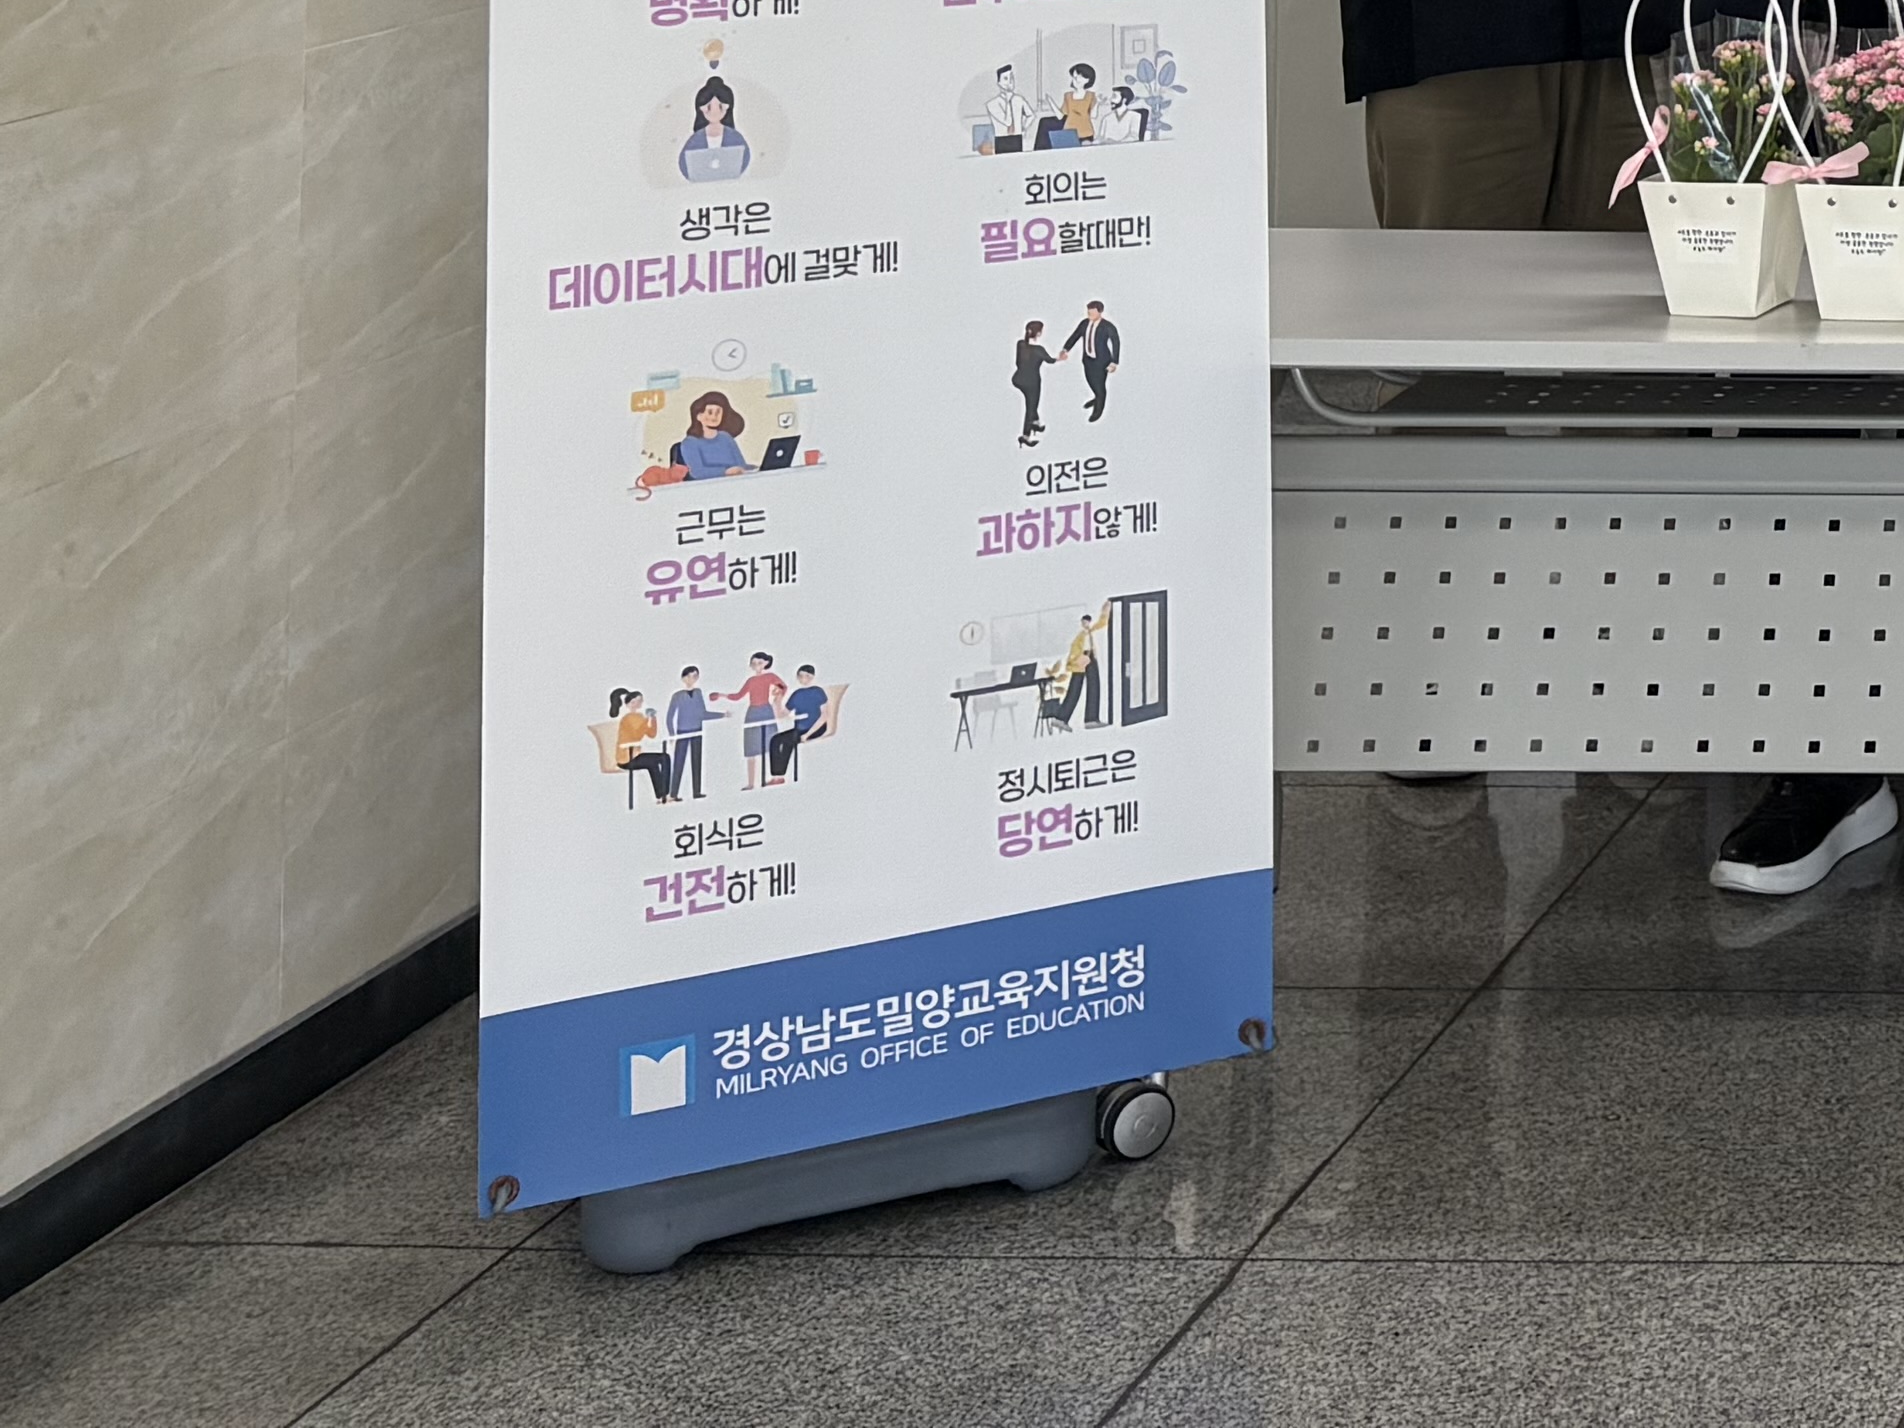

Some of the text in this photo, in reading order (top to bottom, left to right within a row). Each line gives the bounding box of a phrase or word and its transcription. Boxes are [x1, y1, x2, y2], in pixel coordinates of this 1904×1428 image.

[1025, 171, 1106, 205] 회의는
[680, 202, 771, 241] 생각은
[981, 216, 1151, 264] 필요할때만!
[549, 241, 898, 311] 데이터시대에 걸맞게!
[1026, 457, 1108, 496] 의전은
[676, 505, 766, 545] 근무는
[976, 501, 1157, 557] 과하지않게!
[645, 551, 796, 605] 유연하게!
[997, 750, 1137, 803] 정시퇴근은
[674, 814, 764, 859] 회식은
[998, 801, 1138, 858] 당연하게!
[644, 862, 796, 923] 건전하게!
[713, 945, 1145, 1070] 경상남도밀양교육지원청
[716, 991, 1145, 1099] MILRYANG OFFICE OF EDUCATION
